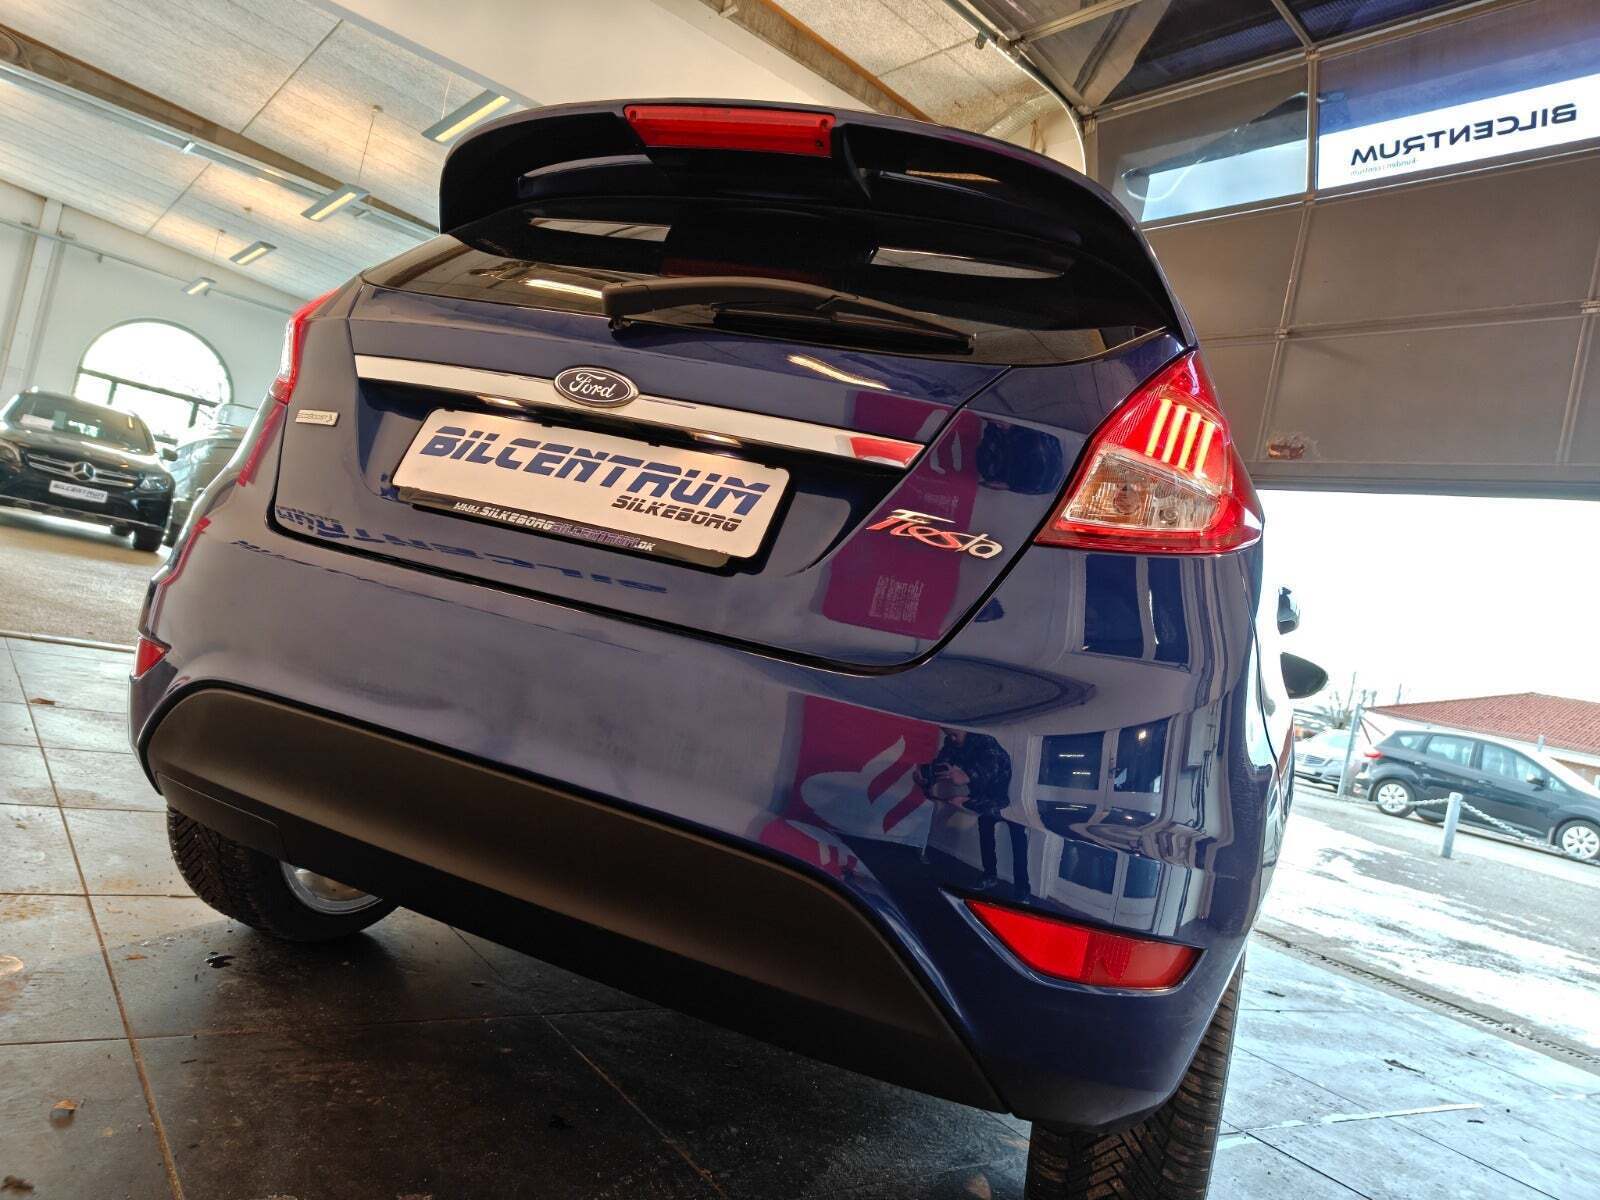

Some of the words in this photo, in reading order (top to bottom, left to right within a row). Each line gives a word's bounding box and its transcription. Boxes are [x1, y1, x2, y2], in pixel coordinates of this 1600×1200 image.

[569, 372, 617, 398] Ford
[419, 425, 771, 516] BILCENTRUM
[610, 494, 743, 532] SILKEBORG
[865, 508, 1003, 559] Fiesta
